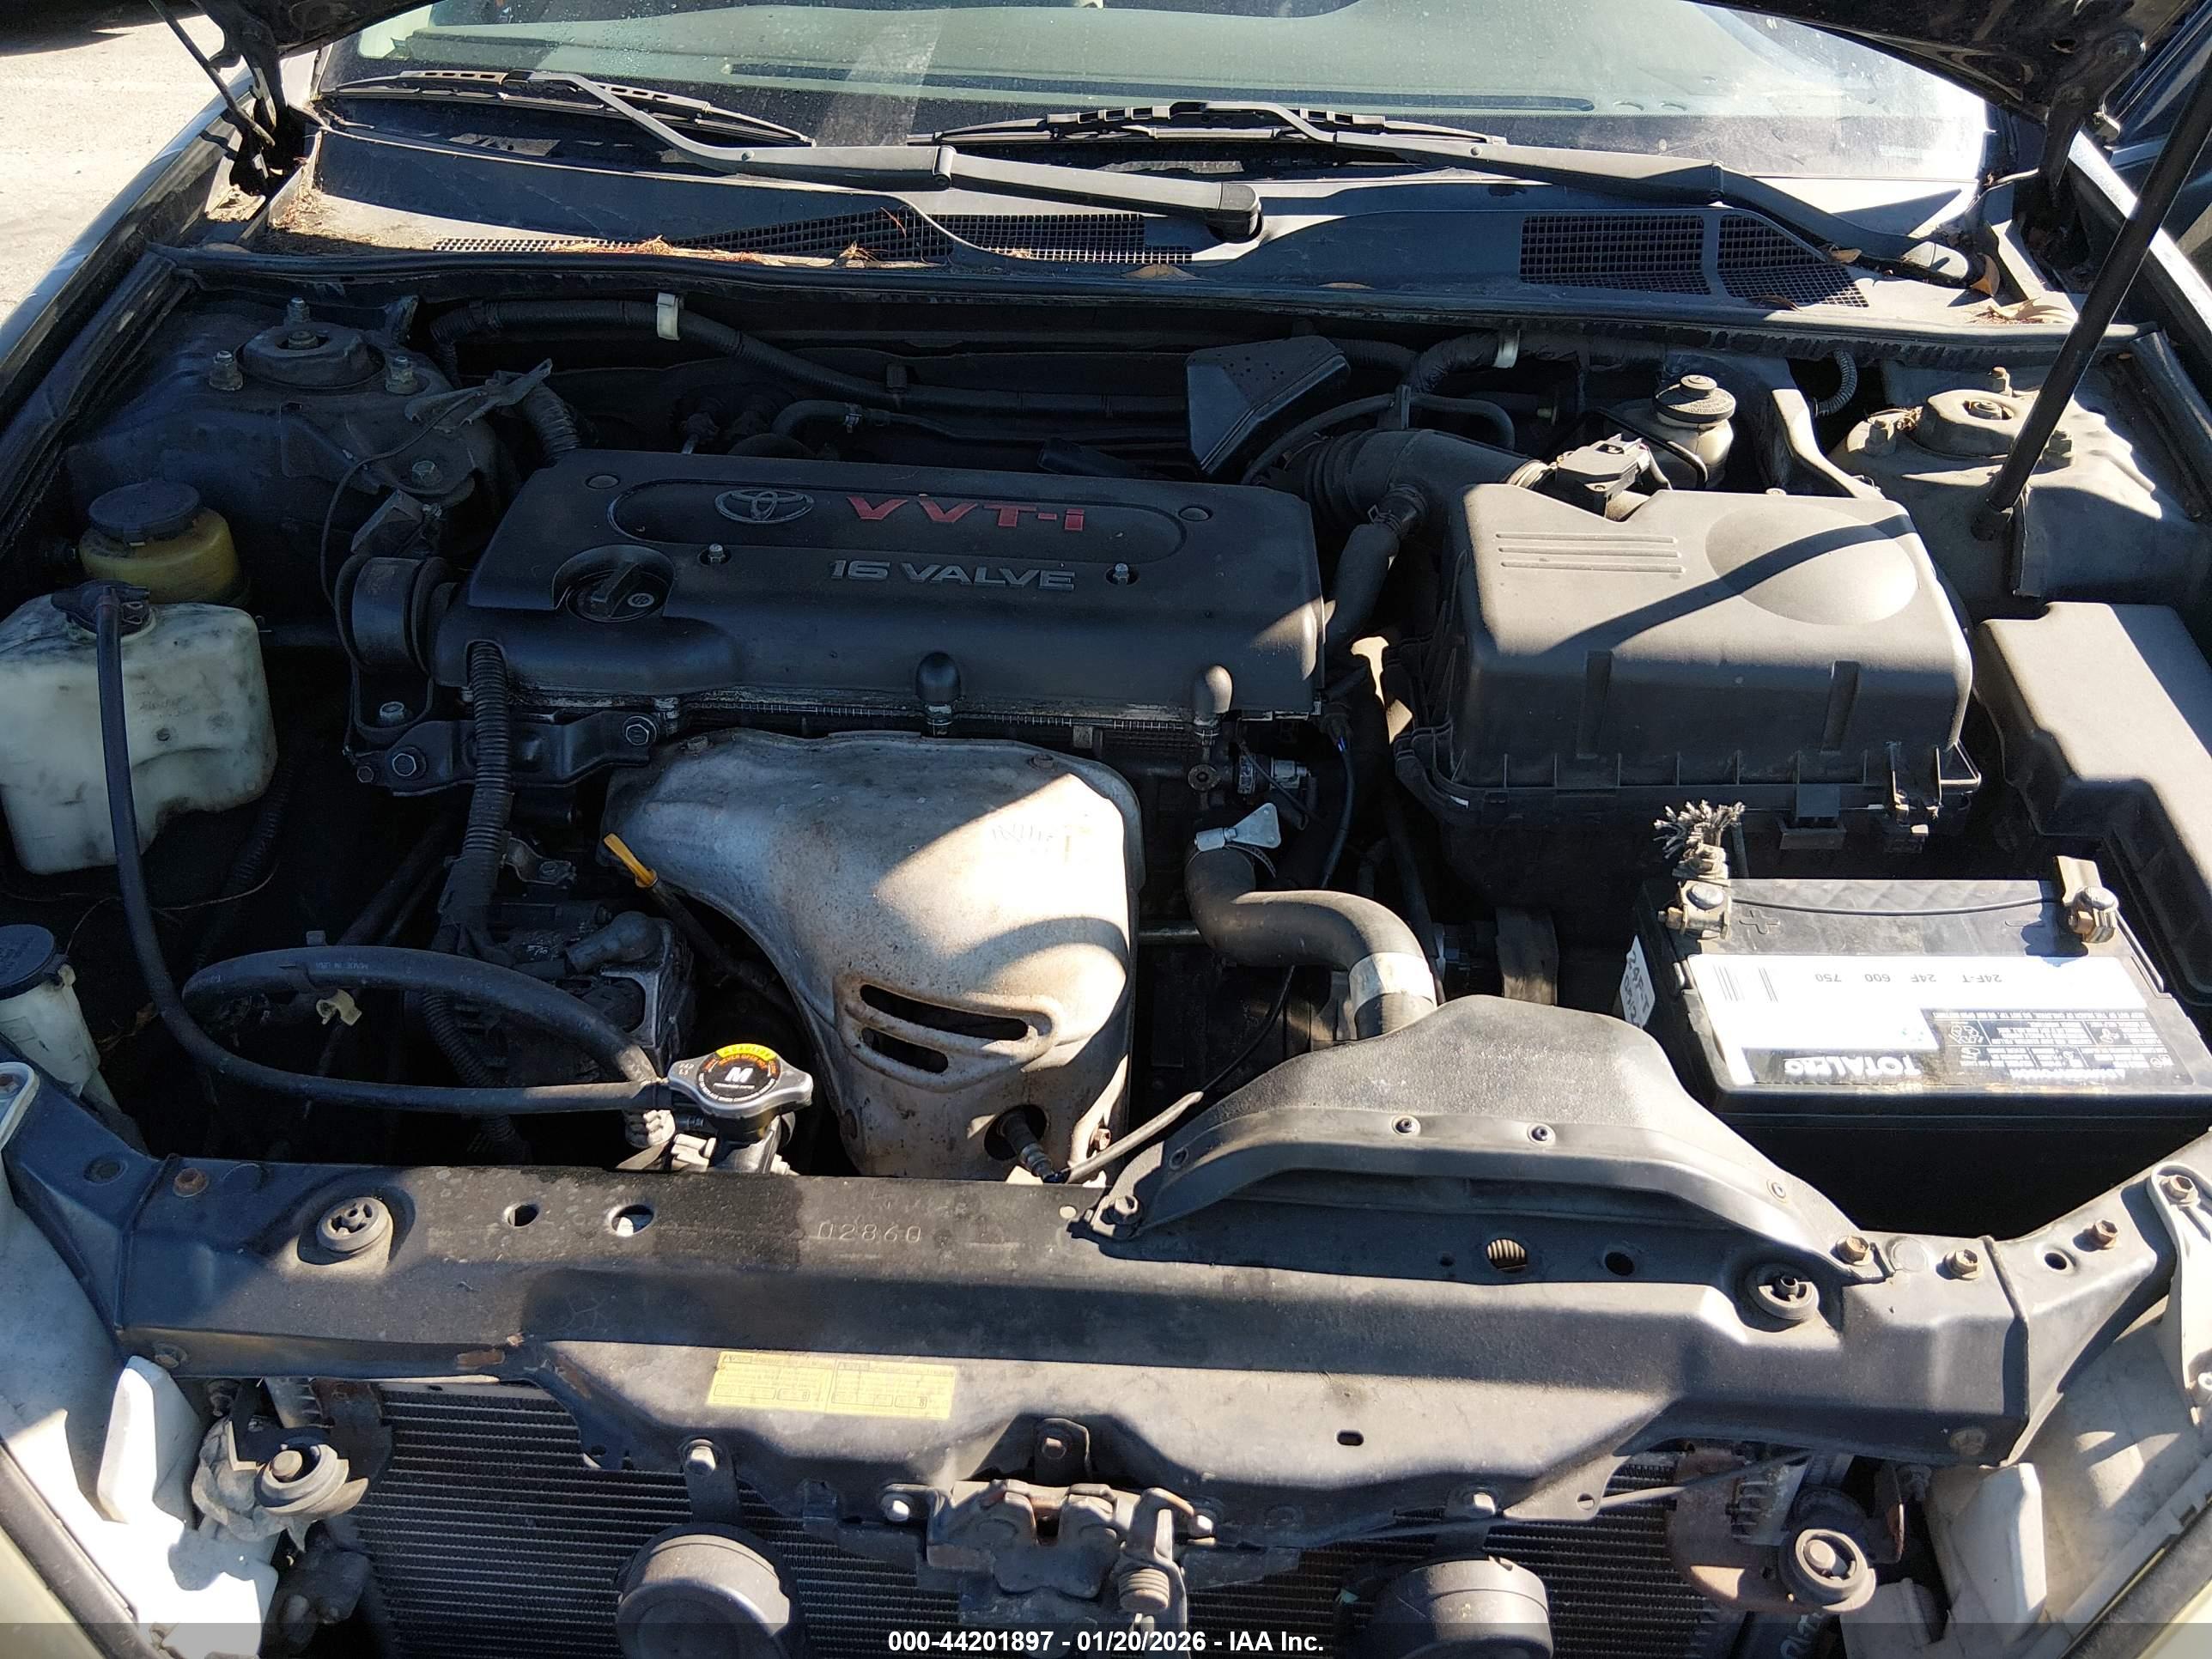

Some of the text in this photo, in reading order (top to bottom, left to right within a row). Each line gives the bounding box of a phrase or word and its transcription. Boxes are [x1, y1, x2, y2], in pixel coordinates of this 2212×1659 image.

[830, 559, 1076, 591] 16 VALVE
[1814, 973, 2002, 983] 24F-T 24F 600 750
[1783, 1054, 1921, 1077] TOTALPRO
[817, 1221, 922, 1243] 02860
